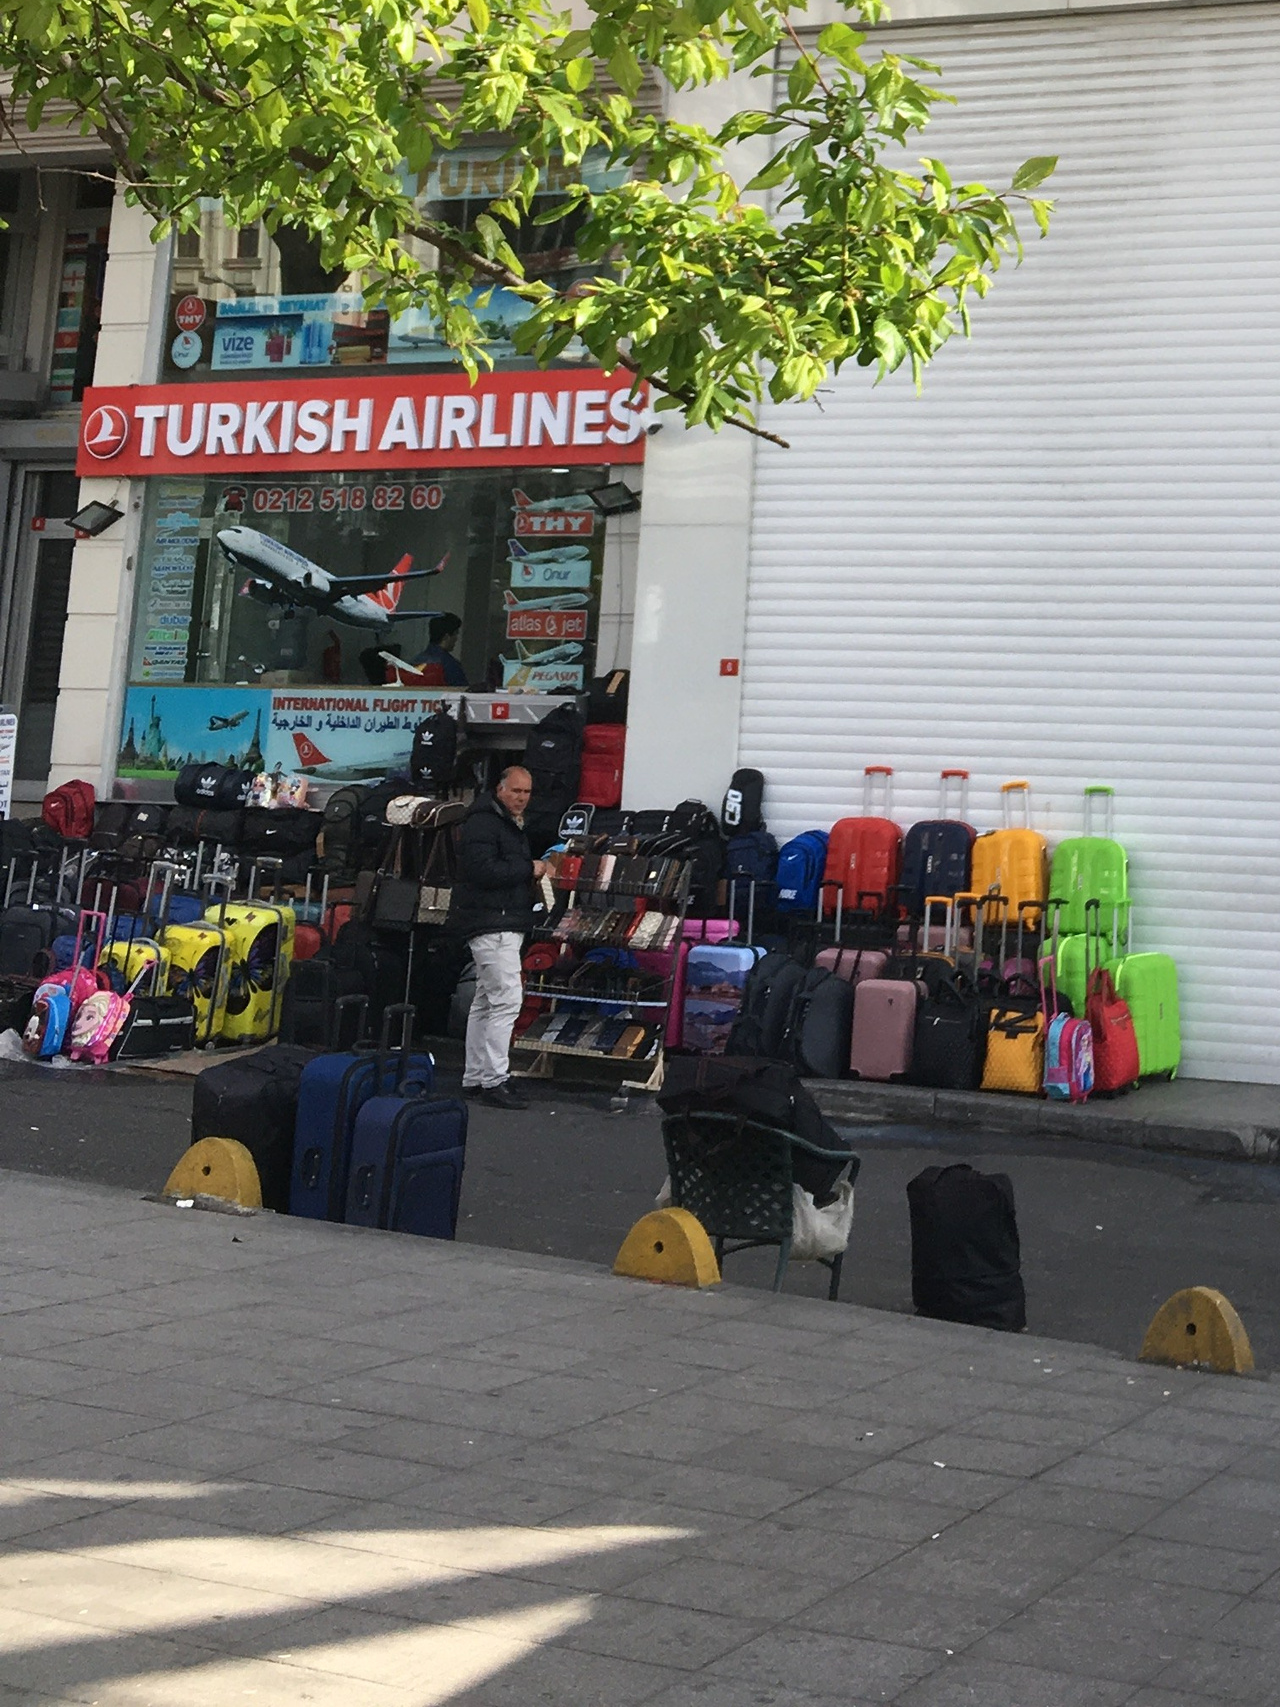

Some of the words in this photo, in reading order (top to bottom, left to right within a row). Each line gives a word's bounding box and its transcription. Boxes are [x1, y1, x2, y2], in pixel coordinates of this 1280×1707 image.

[222, 332, 255, 351] vize
[134, 399, 373, 457] TURKISH
[378, 388, 643, 451] AIRLINES
[253, 488, 314, 513] 0212
[319, 486, 367, 512] 518
[372, 485, 405, 510] 82
[410, 484, 444, 510] 60
[529, 516, 587, 533] THY
[511, 615, 542, 632] atlas
[560, 613, 582, 635] jet
[272, 696, 370, 712] INTERNATIONAL
[373, 698, 418, 712] FLIGHT
